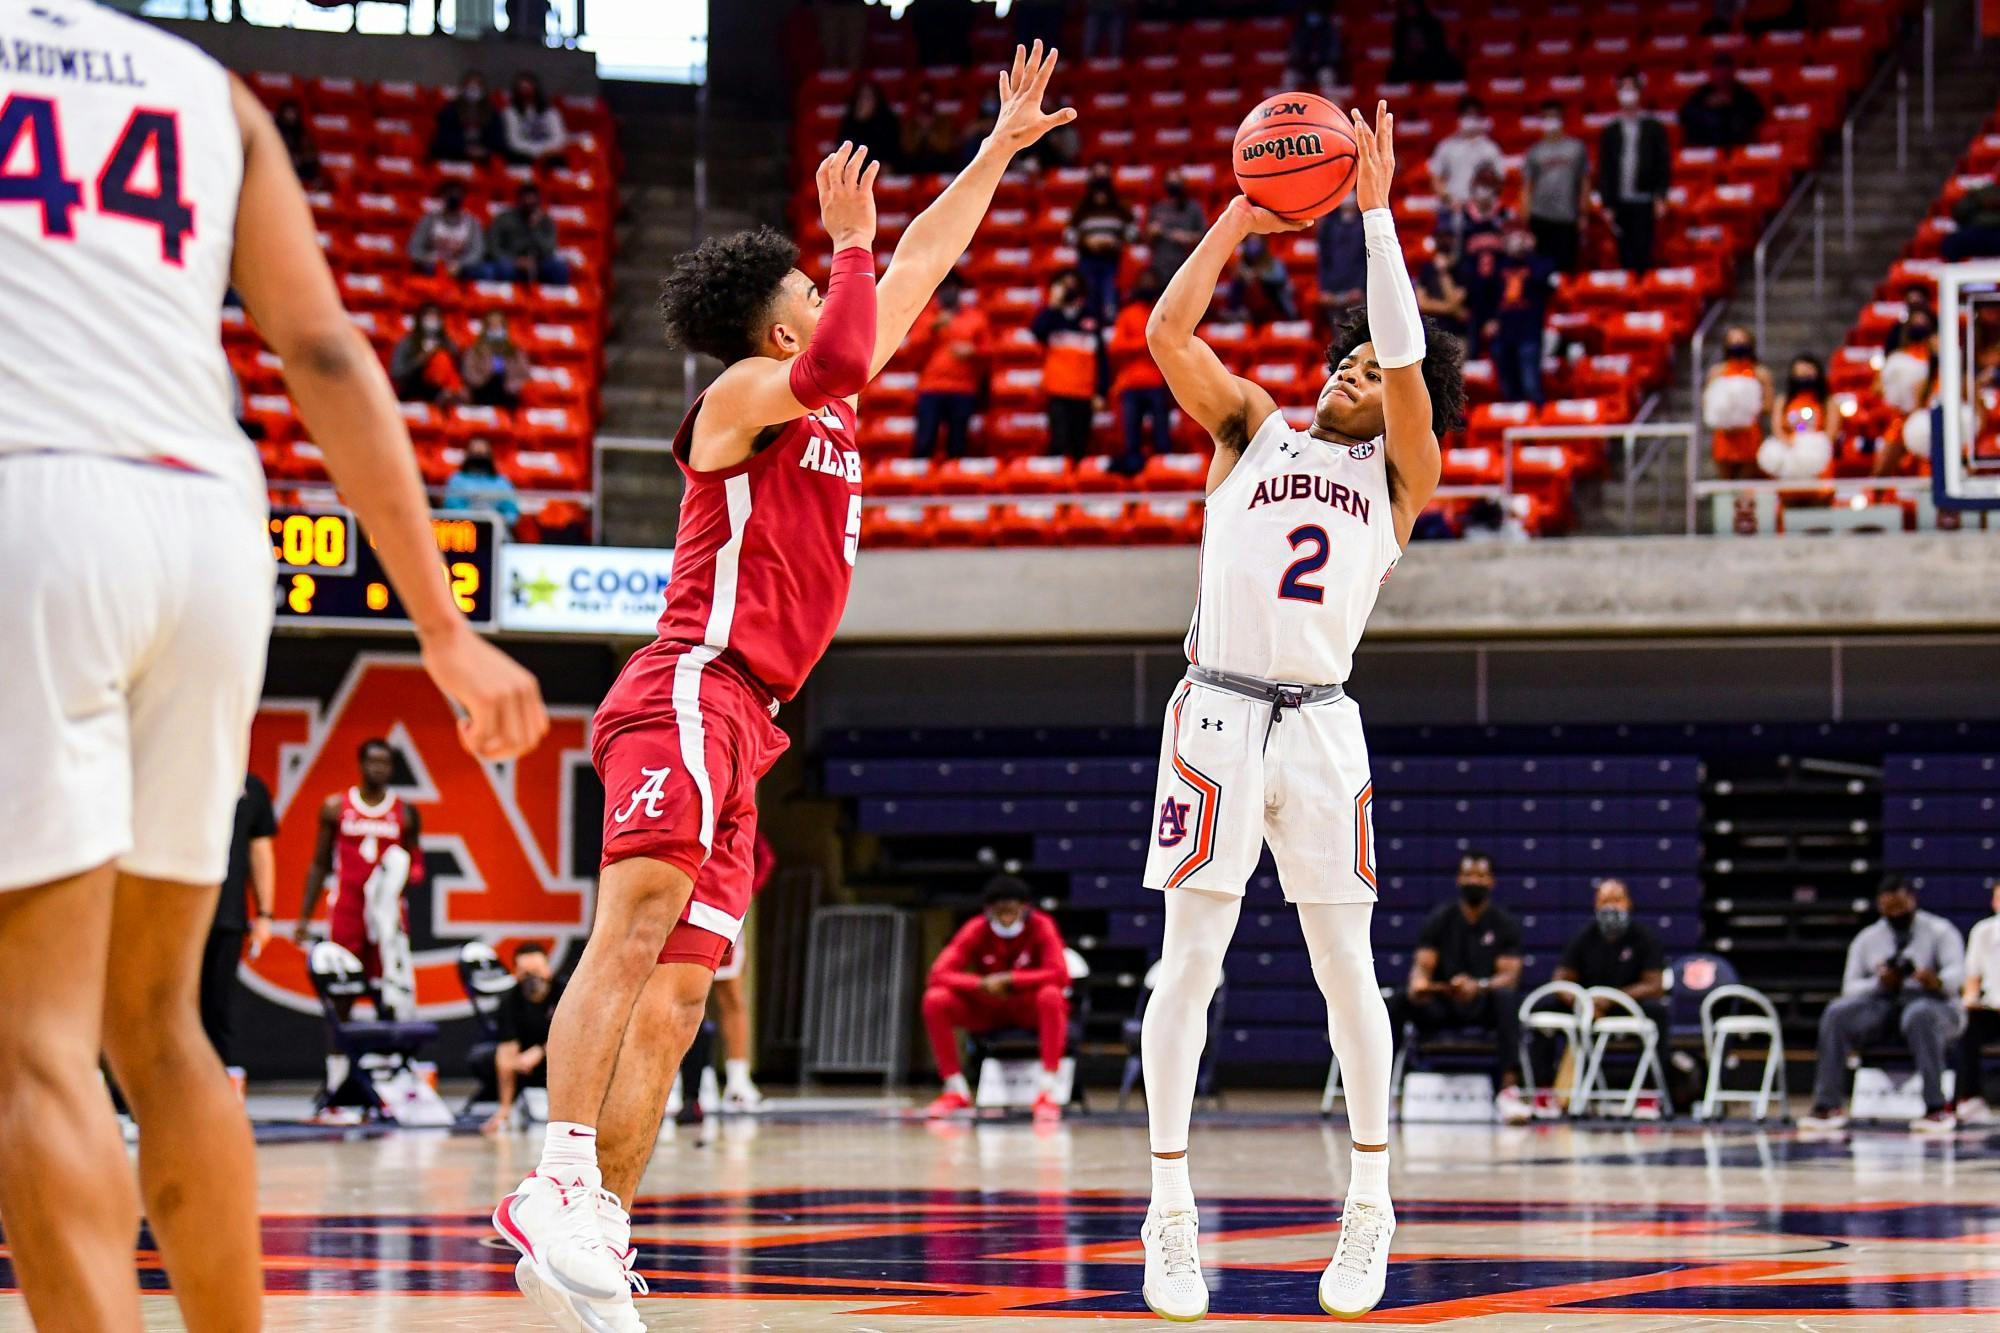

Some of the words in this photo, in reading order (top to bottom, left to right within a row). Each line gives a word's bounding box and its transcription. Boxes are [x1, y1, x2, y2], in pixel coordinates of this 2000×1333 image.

[1250, 102, 1308, 121] NCA
[1241, 133, 1325, 162] Wilson
[0, 91, 196, 269] 44
[1350, 443, 1374, 459] SEC
[1247, 473, 1370, 526] AUBURN
[1277, 523, 1331, 605] 2
[614, 766, 672, 823] A
